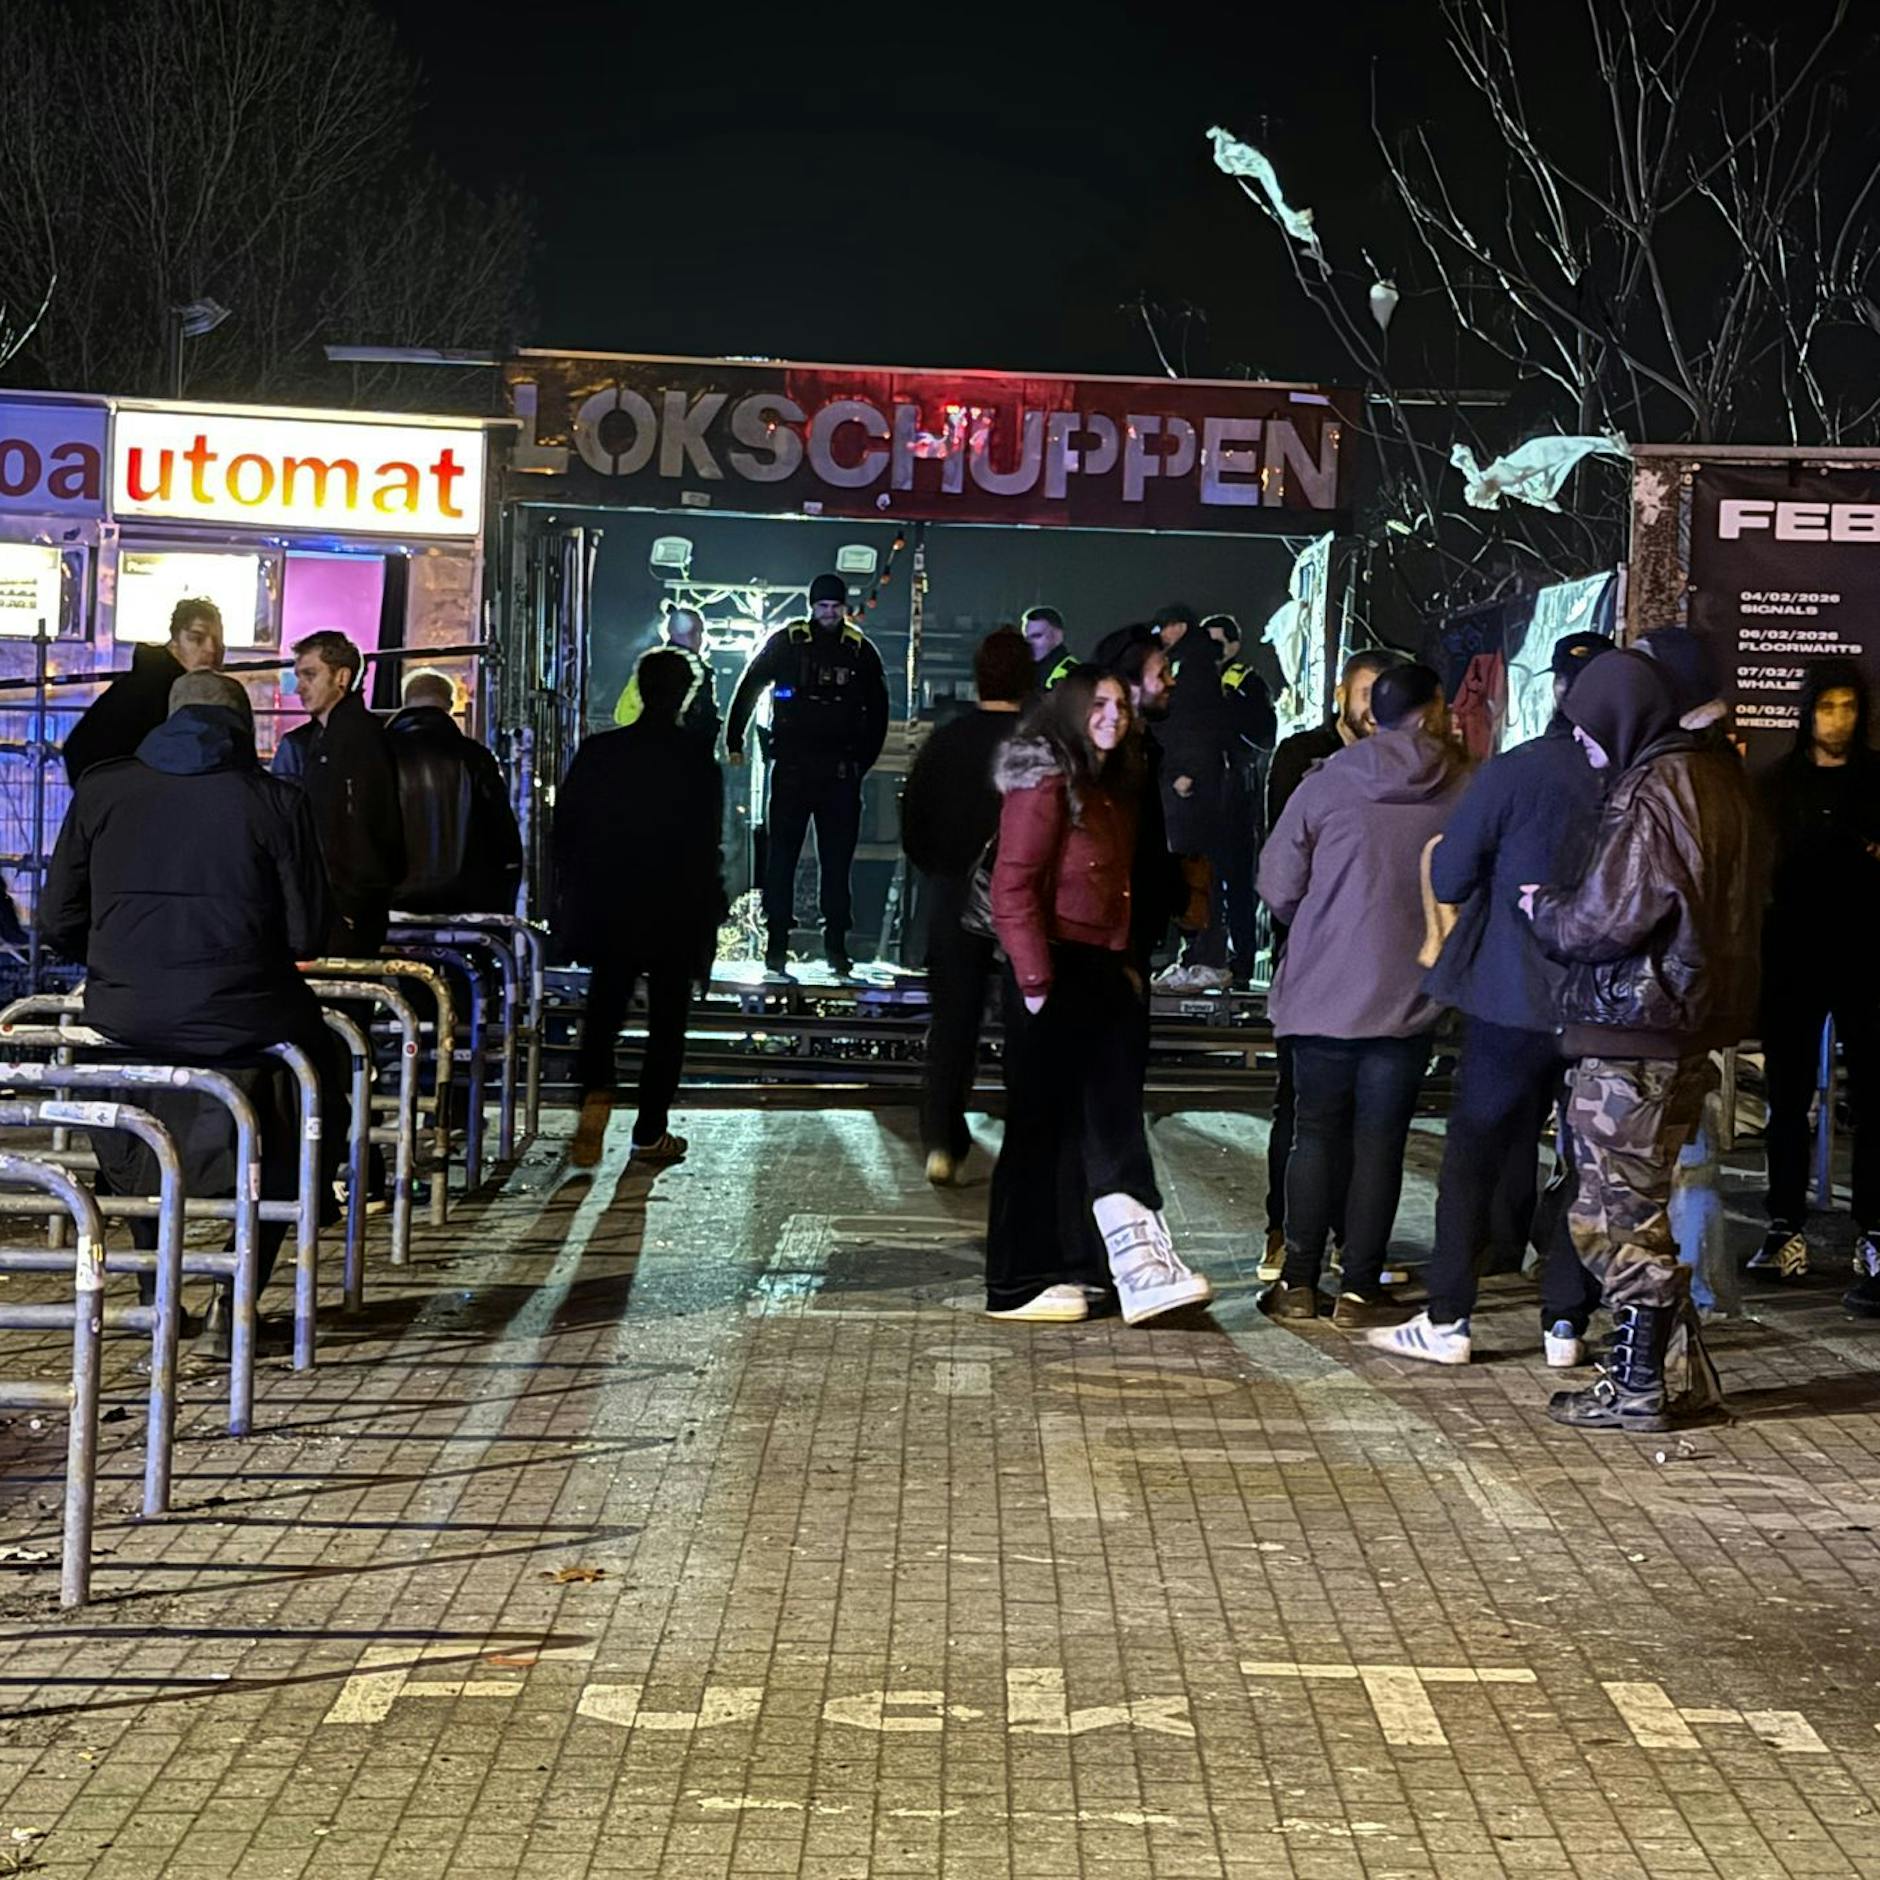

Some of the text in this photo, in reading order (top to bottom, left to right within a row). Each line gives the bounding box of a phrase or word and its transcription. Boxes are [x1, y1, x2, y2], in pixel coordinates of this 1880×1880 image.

[511, 383, 1341, 511] LOKSCHUPPEN
[126, 434, 465, 518] utomat
[1718, 499, 1880, 543] FEB
[1740, 591, 1841, 604] 04/02/2026
[1739, 604, 1818, 615] SIGNALS
[1738, 628, 1839, 641] 06/02/2026
[1737, 641, 1863, 654] FLOORWARTS
